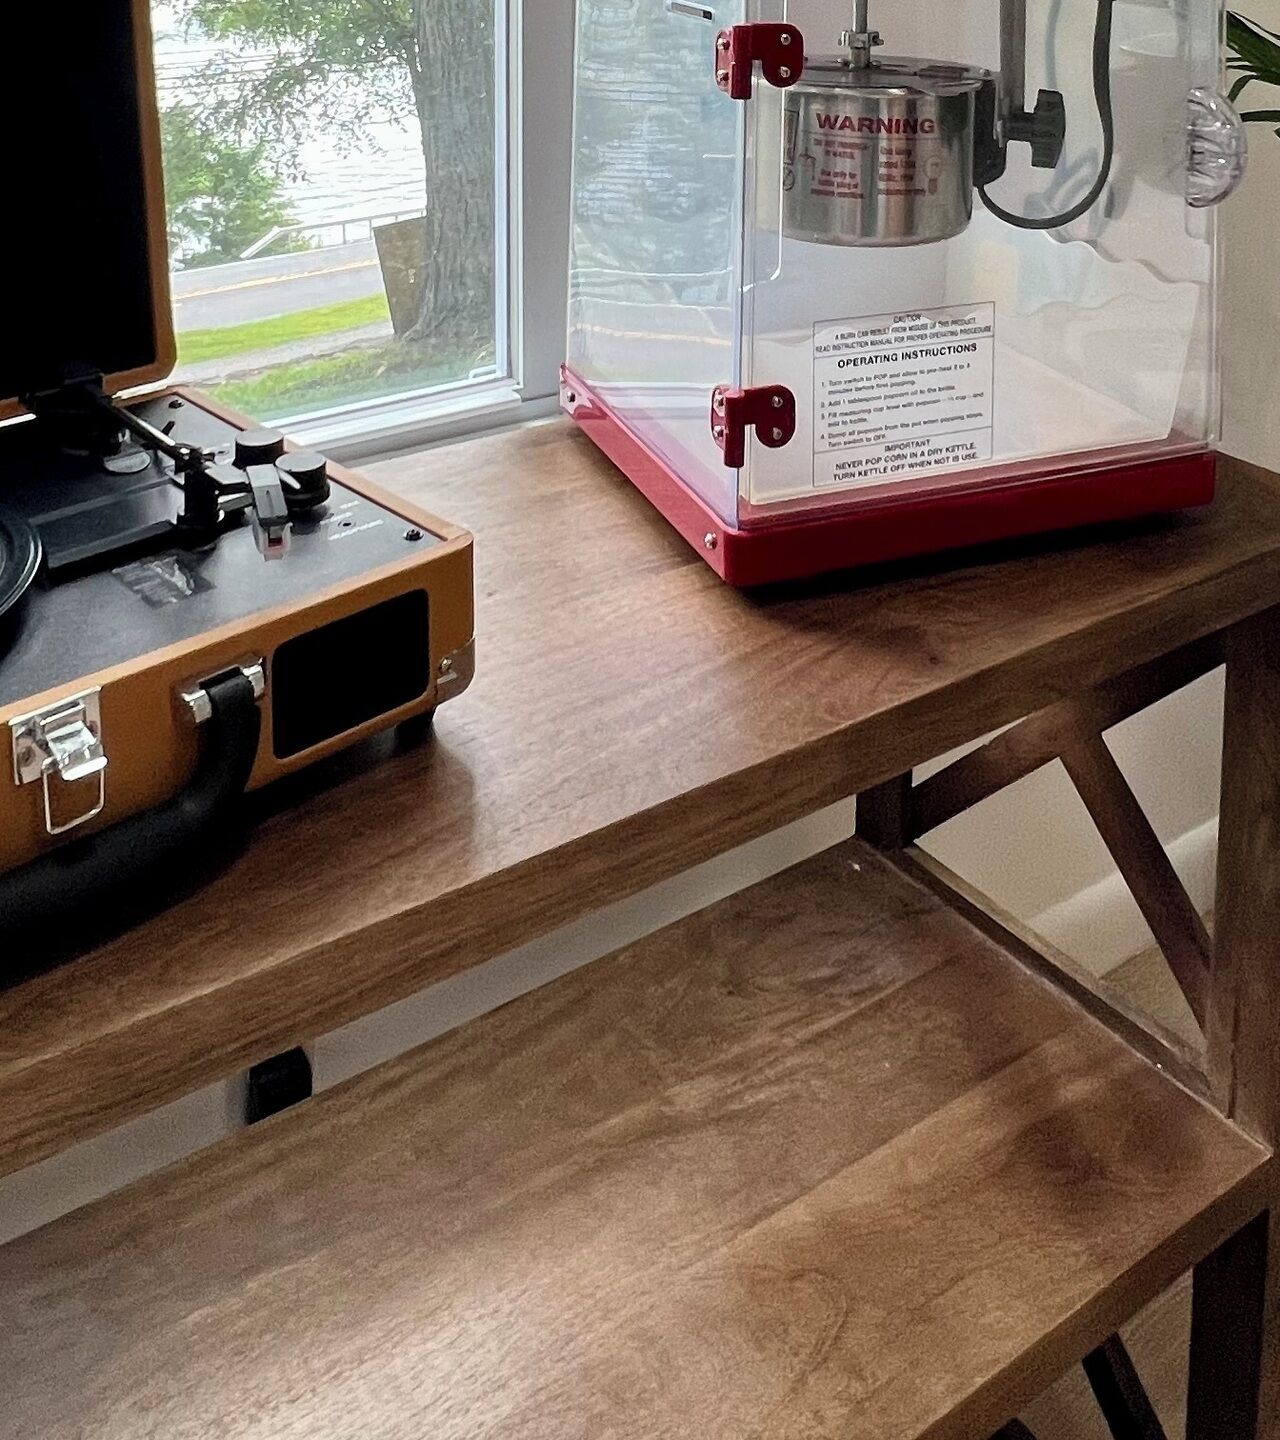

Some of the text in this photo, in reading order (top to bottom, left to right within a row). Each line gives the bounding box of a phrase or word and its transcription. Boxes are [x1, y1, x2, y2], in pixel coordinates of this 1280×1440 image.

[816, 112, 935, 135] WARNING
[838, 342, 977, 368] OPERATING INSTRUCTIONS
[885, 439, 930, 452] IMPORTANT
[833, 471, 856, 481] TURN
[858, 466, 888, 477] KETTLE
[890, 463, 905, 472] OFF
[908, 460, 932, 470] WHEN
[934, 456, 950, 465] NOT
[836, 460, 863, 470] NEVER
[865, 456, 882, 466] POP
[884, 452, 908, 463] CORN
[910, 451, 917, 459] IN
[928, 448, 943, 456] DRY
